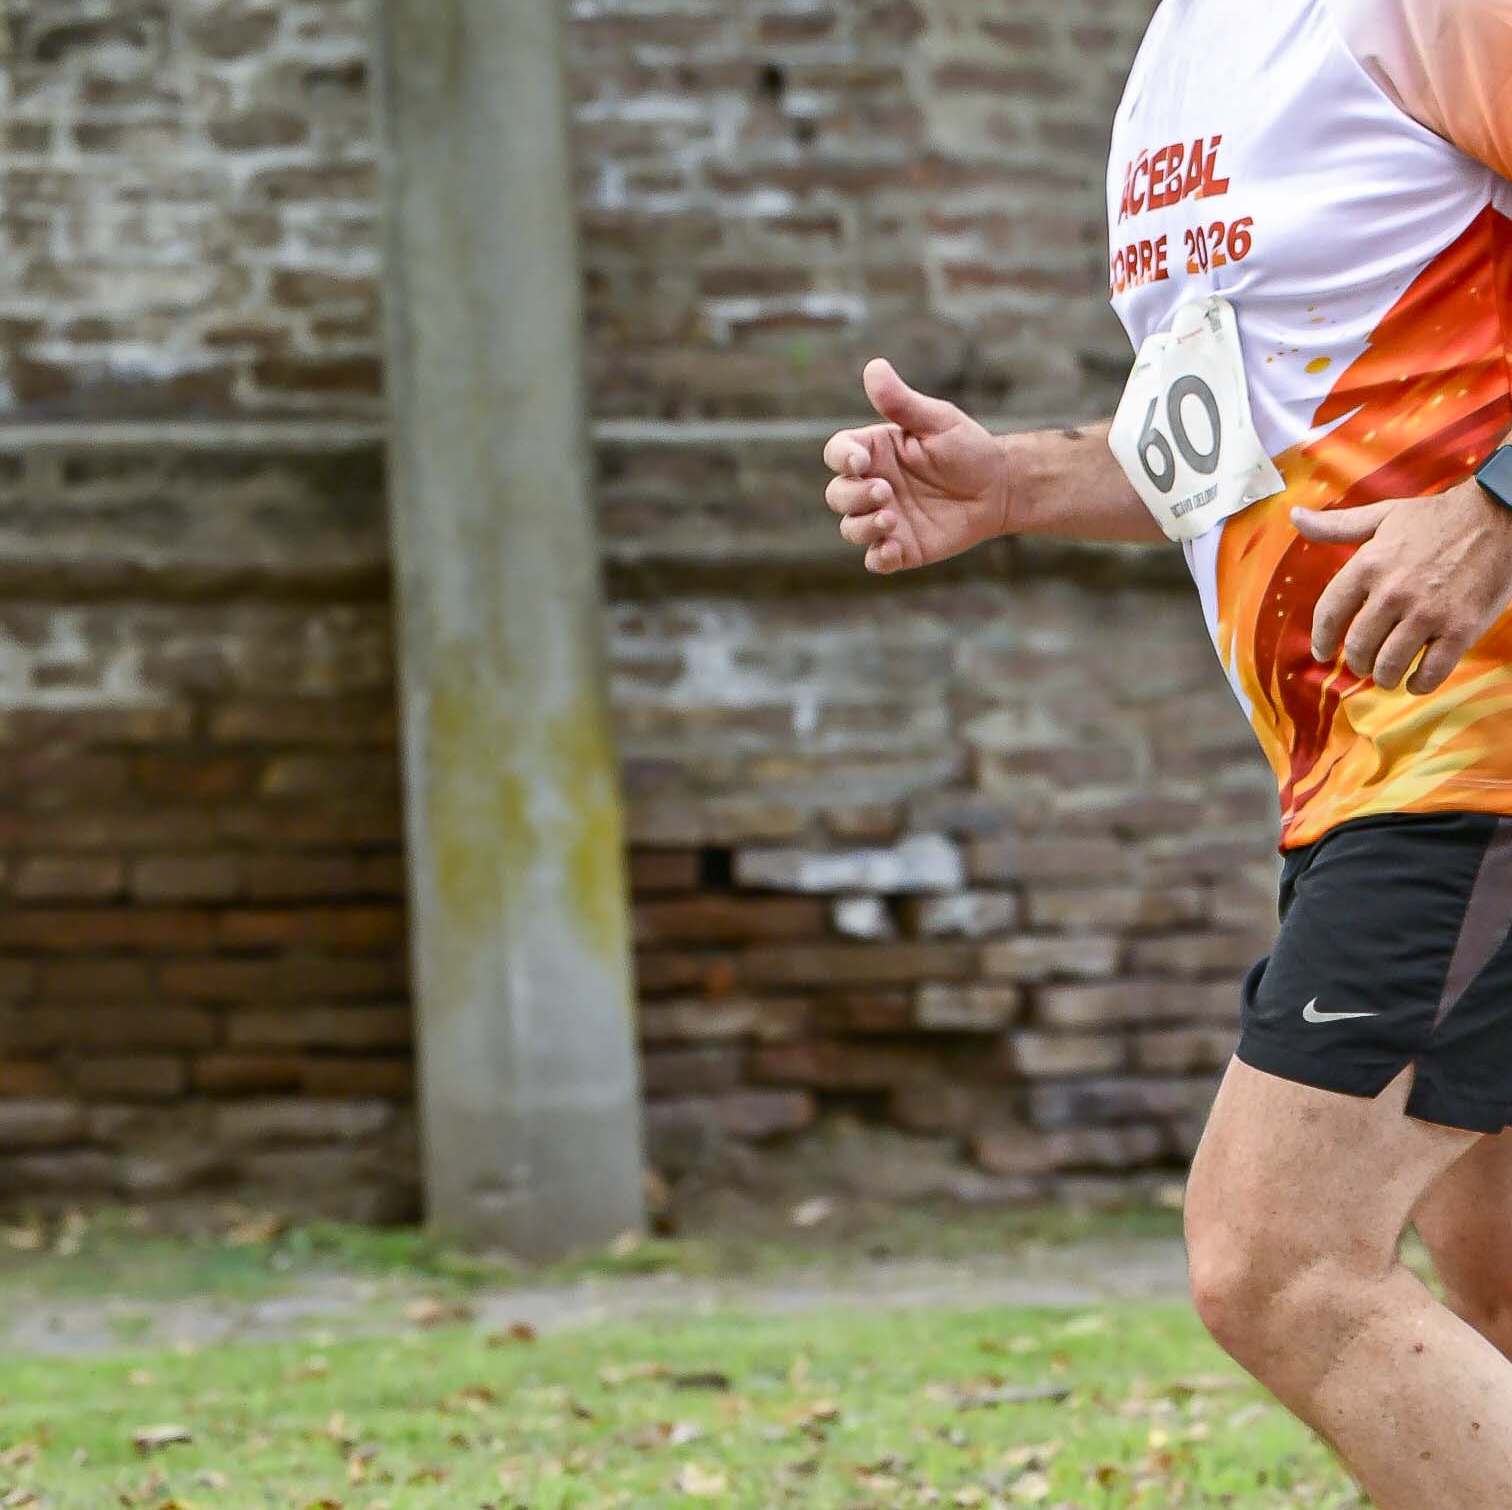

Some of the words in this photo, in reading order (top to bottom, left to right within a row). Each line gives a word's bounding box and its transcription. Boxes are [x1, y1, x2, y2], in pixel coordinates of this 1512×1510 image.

[1118, 134, 1230, 226] ACEBAL
[1184, 217, 1253, 274] 2026
[1137, 375, 1221, 493] 60
